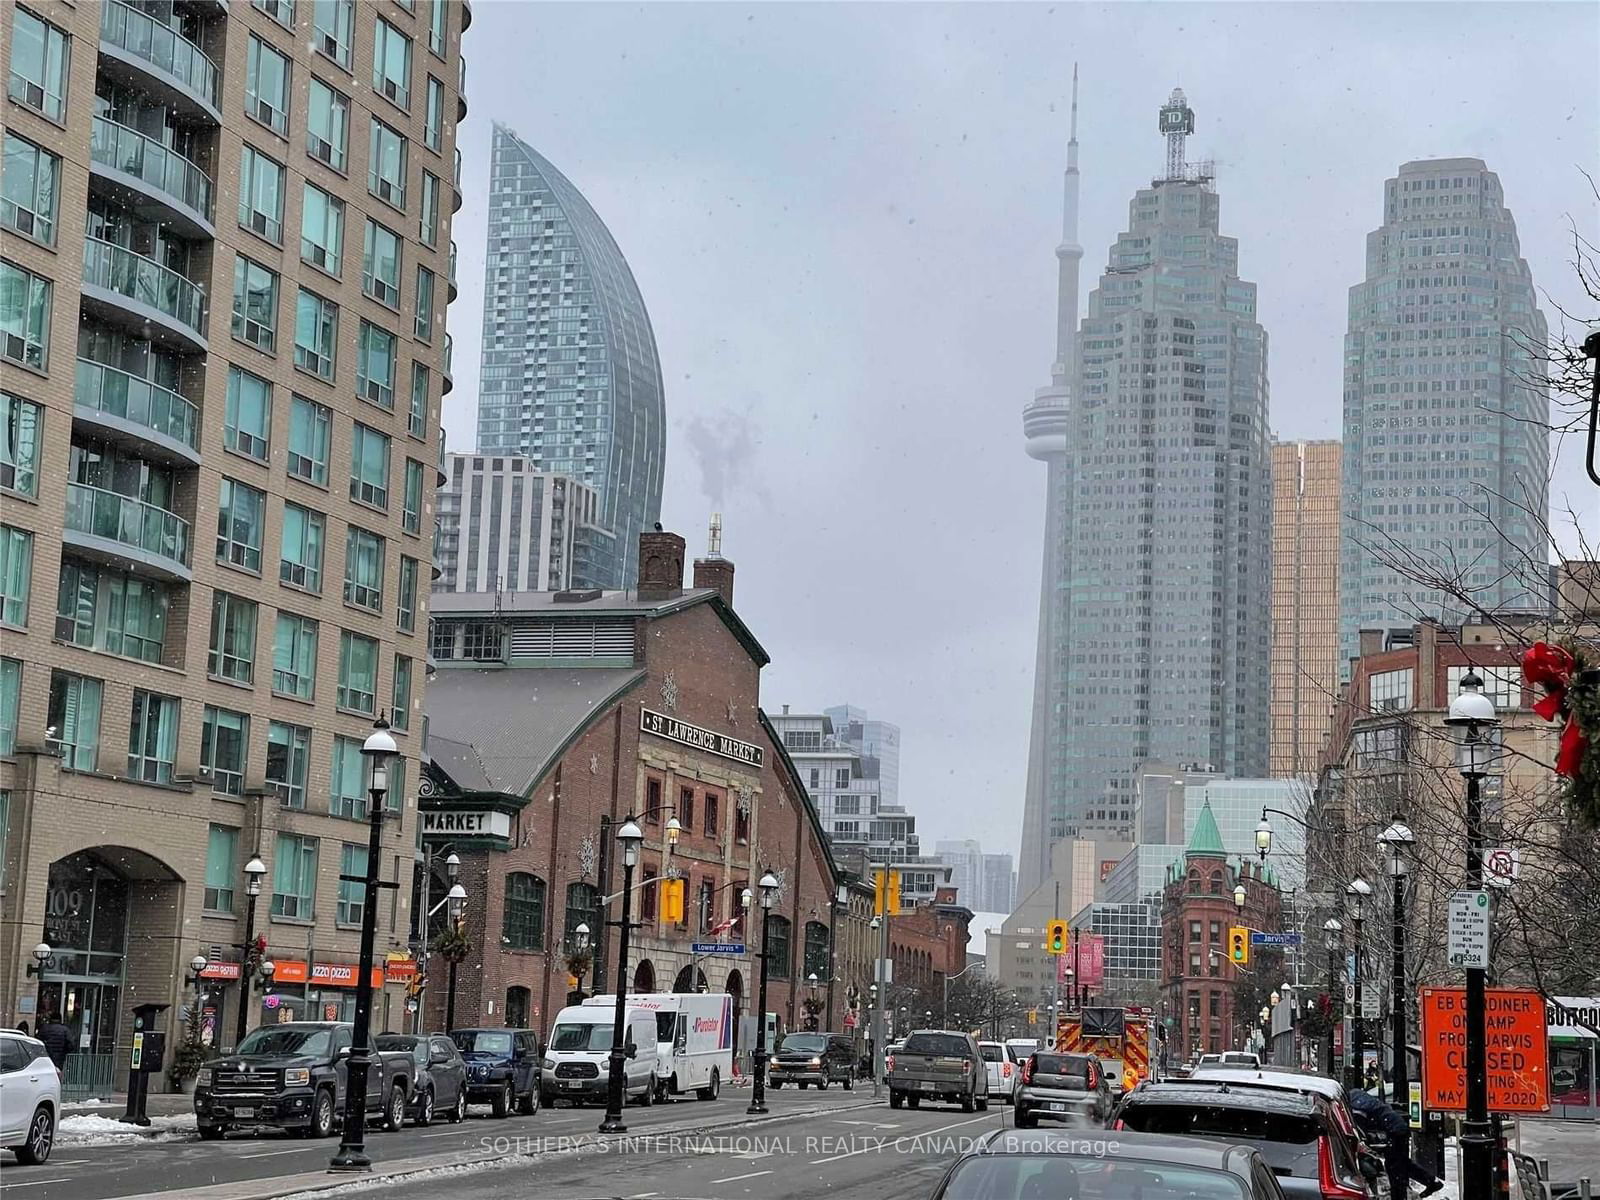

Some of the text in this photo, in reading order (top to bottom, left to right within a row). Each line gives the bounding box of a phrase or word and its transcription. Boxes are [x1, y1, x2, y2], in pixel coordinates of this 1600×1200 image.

[1166, 111, 1182, 123] TD
[668, 721, 715, 750] LAWRENCE
[720, 738, 755, 762] MARKET
[424, 813, 485, 831] MARKET
[48, 888, 81, 917] 109
[1463, 953, 1481, 962] 5324
[312, 966, 330, 977] izza
[330, 967, 351, 982] pizza
[1437, 996, 1455, 1010] EB
[1487, 1016, 1516, 1029] AMP
[1440, 1032, 1532, 1048] FRO JARVIS
[1447, 1051, 1525, 1070] CLSED
[1438, 1091, 1464, 1104] MAY
[1503, 1092, 1537, 1105] 2020
